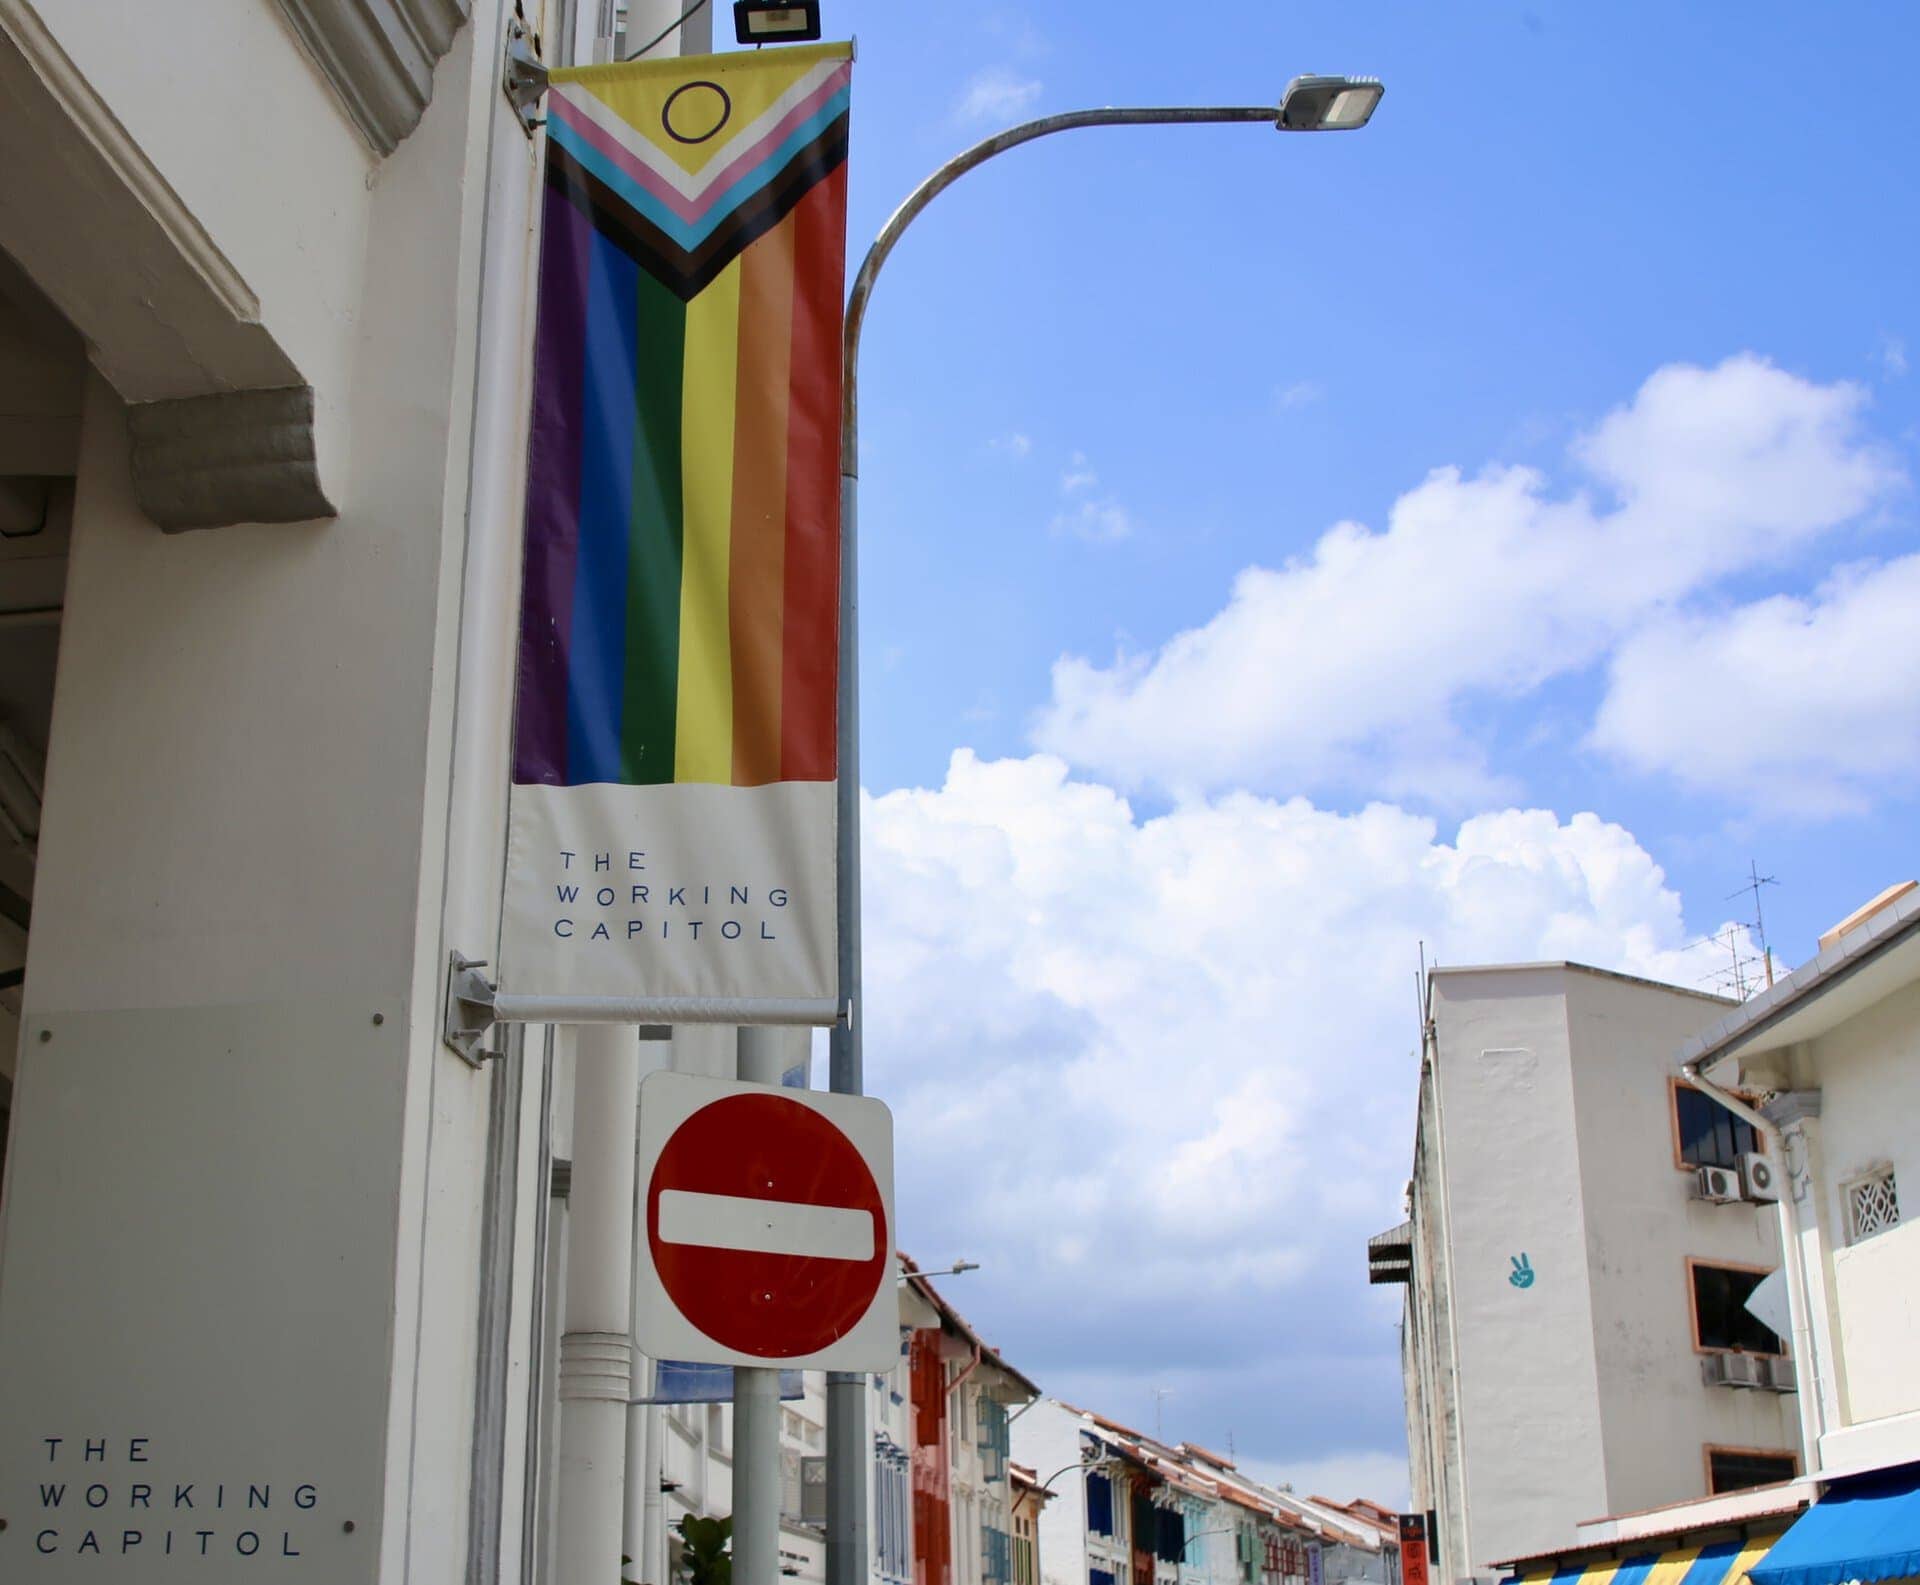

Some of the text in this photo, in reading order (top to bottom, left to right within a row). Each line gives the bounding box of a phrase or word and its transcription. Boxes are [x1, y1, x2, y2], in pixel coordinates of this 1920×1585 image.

[559, 851, 646, 872] THE
[556, 885, 788, 907] WORKING
[554, 919, 776, 941] CAPITOL
[44, 1438, 149, 1462] THE
[40, 1484, 317, 1509] WORKING
[36, 1530, 300, 1556] CAPITOL
